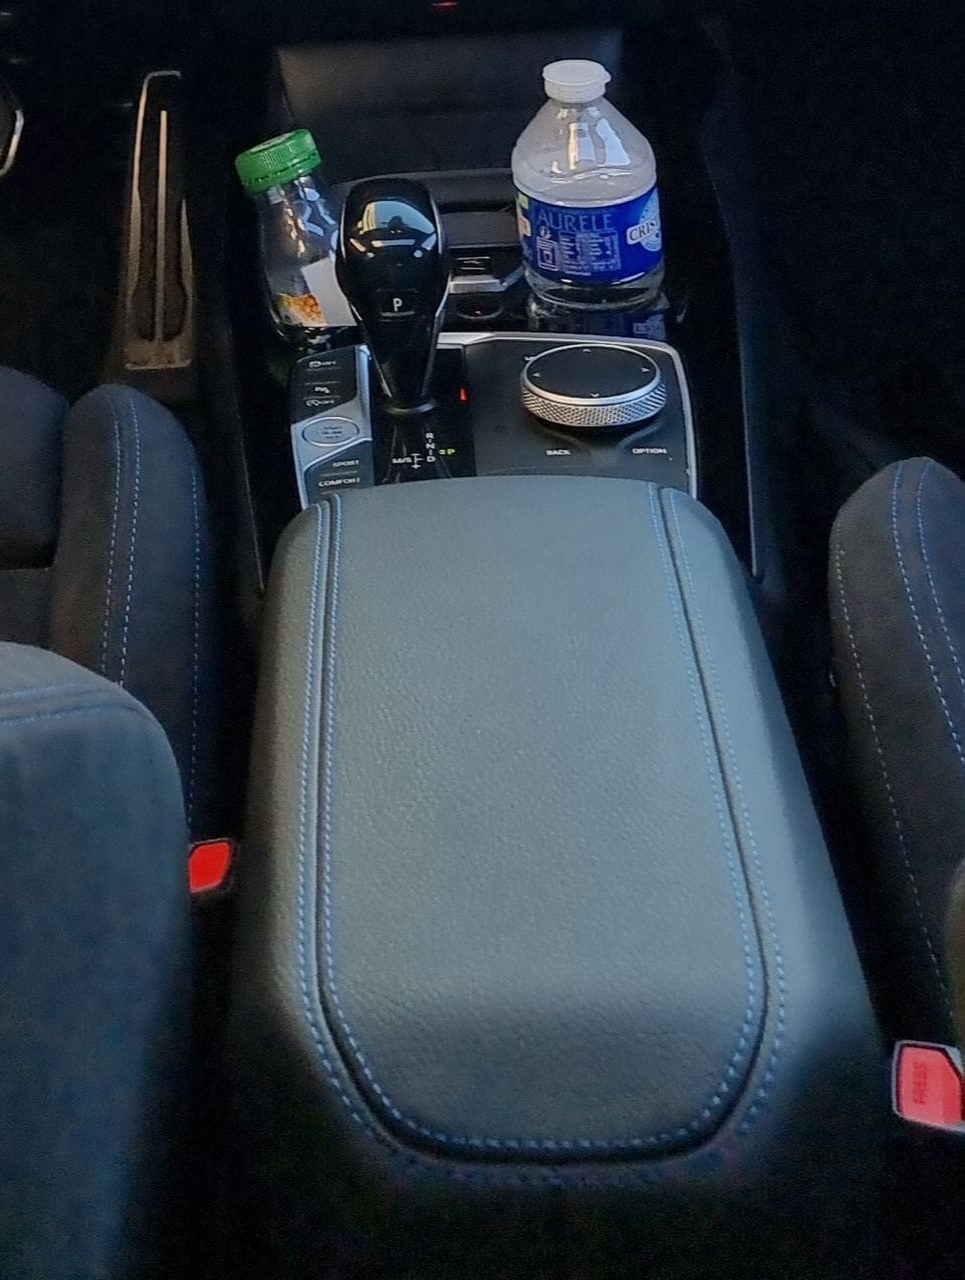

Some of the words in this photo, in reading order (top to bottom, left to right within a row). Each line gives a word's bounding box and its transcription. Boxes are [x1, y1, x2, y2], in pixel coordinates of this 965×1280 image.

[537, 208, 614, 233] AURELE
[392, 297, 403, 312] P
[318, 477, 361, 487] COMFORT
